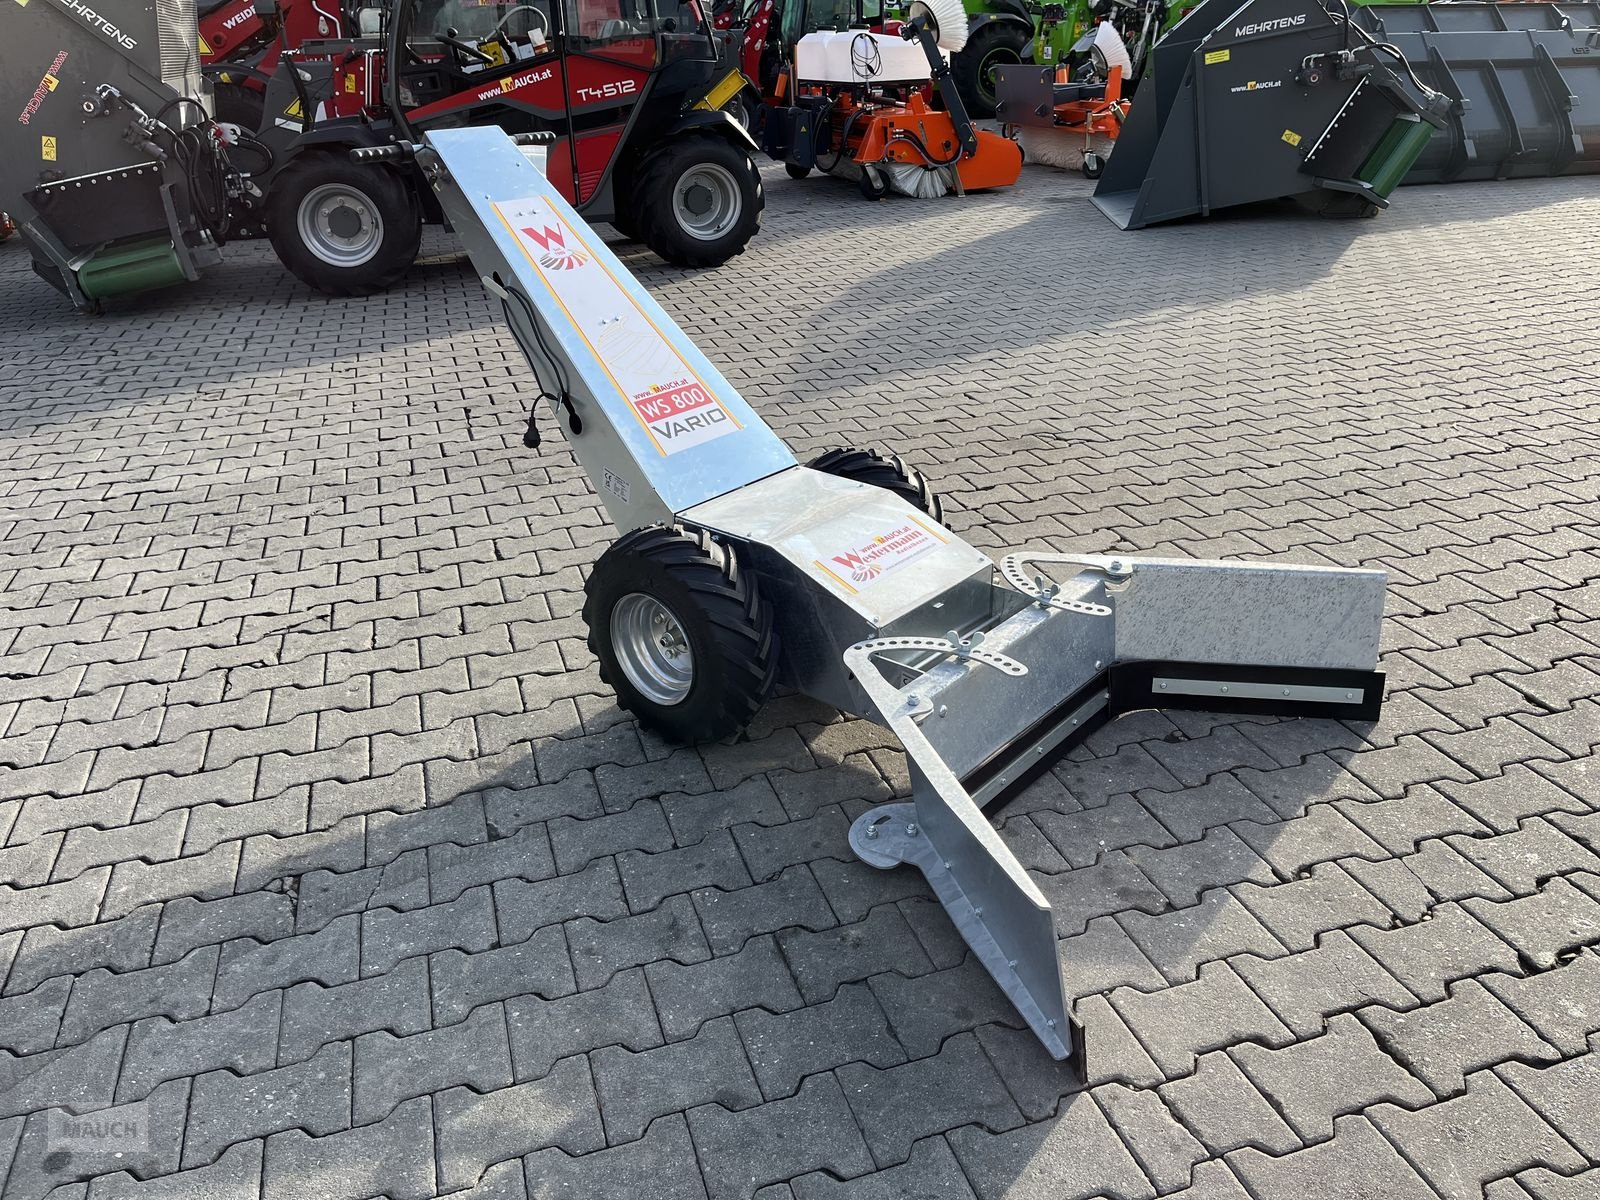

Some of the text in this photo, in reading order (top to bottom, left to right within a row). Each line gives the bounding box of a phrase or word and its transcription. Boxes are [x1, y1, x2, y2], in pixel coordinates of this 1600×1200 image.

[1235, 14, 1306, 37] MEHRTENS
[18, 50, 68, 125] www.MAUCH.at
[477, 68, 552, 101] www.MAUCH.at
[576, 79, 636, 101] T4512
[1231, 80, 1281, 92] www.MAUCH.at
[633, 378, 689, 399] www.MAUCH.at
[640, 387, 705, 418] WS 800
[831, 530, 923, 570] Westermann
